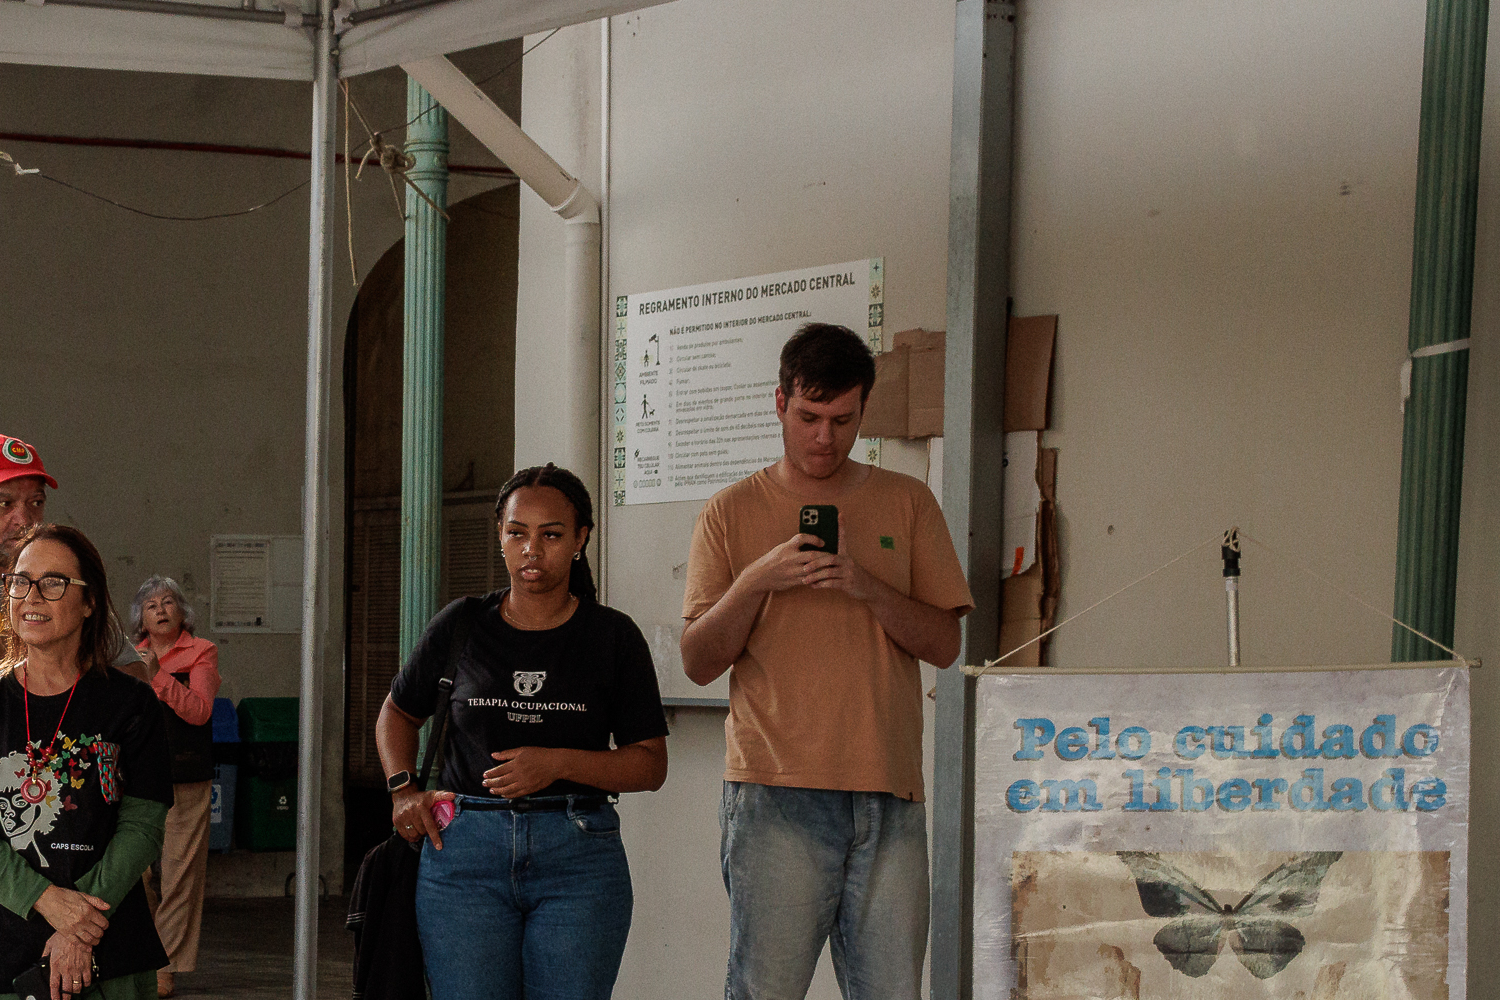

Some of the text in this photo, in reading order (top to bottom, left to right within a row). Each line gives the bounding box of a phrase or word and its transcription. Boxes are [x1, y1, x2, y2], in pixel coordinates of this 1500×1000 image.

[639, 272, 855, 316] REGRAMENTO INTERNO DO MERCADO CENTRAL
[670, 324, 681, 336] NÃO
[685, 322, 714, 334] PERMITIDO
[714, 321, 723, 331] NO
[723, 318, 749, 329] INTERIOR
[749, 316, 757, 326] DO
[757, 313, 784, 324] MERCADO
[468, 698, 587, 712] TERAPIA OCUPACIONAL
[507, 711, 543, 723] UFPEL
[1012, 713, 1439, 761] Pelo cuidado
[1005, 766, 1448, 813] em liberdade
[51, 842, 94, 851] CAPS ESCOLA
